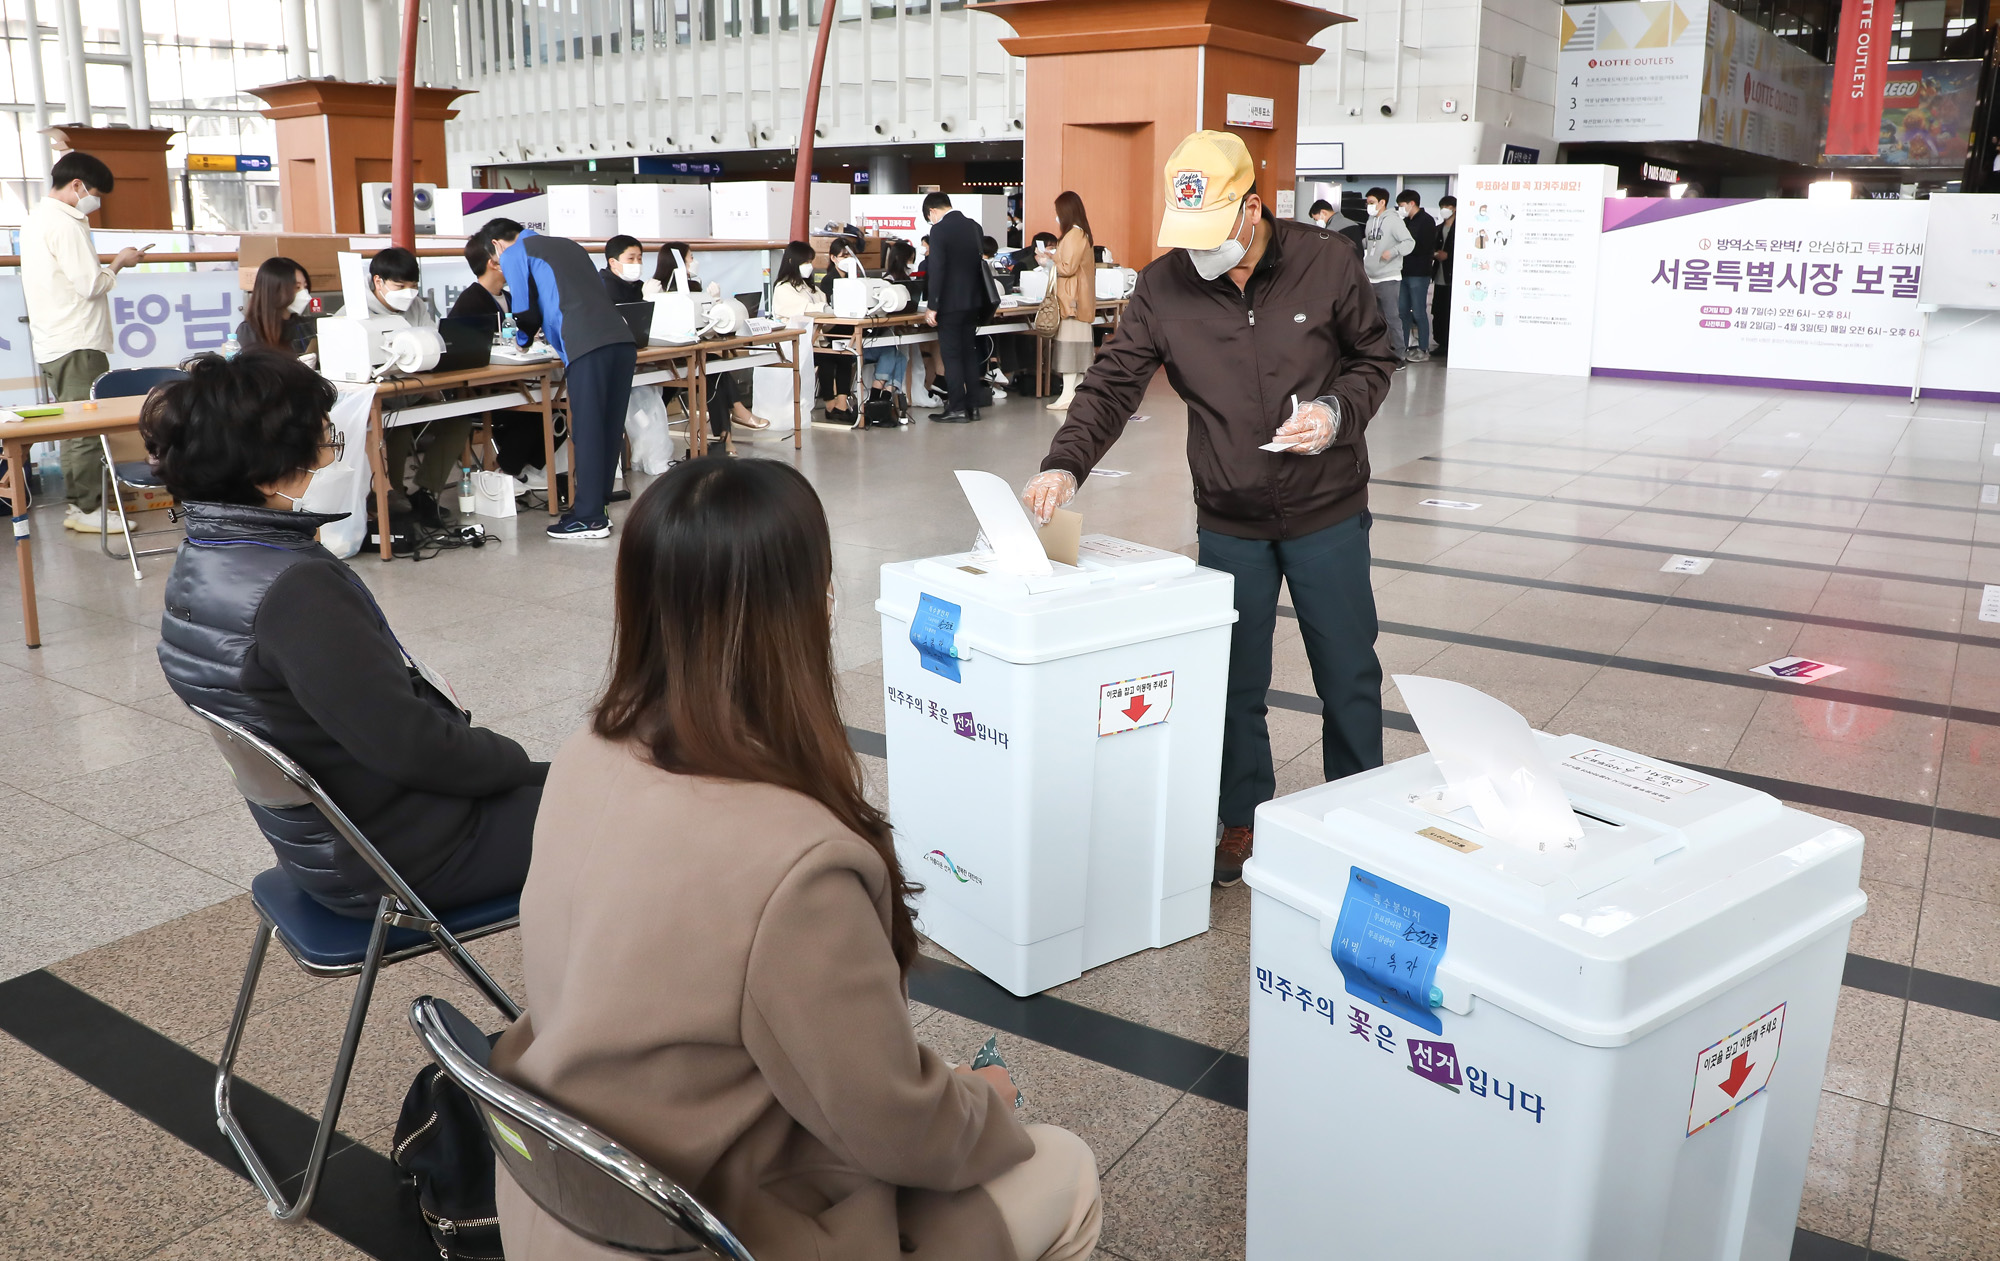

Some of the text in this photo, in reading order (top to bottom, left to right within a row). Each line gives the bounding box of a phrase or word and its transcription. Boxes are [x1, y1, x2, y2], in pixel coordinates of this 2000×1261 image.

[1600, 57, 1674, 67] LOTTE OUTLETS
[1851, 33, 1870, 98] OUTLETS
[1571, 76, 1578, 87] 4
[1883, 82, 1918, 97] LEGO
[1570, 97, 1577, 109] 3
[1751, 80, 1774, 108] LOTTE
[1568, 119, 1576, 130] 2
[1476, 181, 1581, 191] 투표하실 때 꼭 지켜주세요!
[1717, 238, 1923, 256] 방역소독 완벽! 안심하고 투표하세
[1651, 258, 1921, 298] 서울특별시장 보궐
[1735, 307, 1748, 315] 4월
[1751, 307, 1777, 316] 7일(수)
[1779, 308, 1794, 317] 오전
[1836, 311, 1851, 319] 8시
[1734, 321, 1747, 329] 4월
[1750, 321, 1776, 331] 2일(금)
[1784, 323, 1797, 331] 4월
[1800, 323, 1828, 333] 3일(토)
[1830, 325, 1847, 334] 매일
[1849, 326, 1865, 335] 오전
[1107, 679, 1168, 699] 이곳을 잡고 이동해 주세요
[888, 686, 1009, 750] 민주주의 꽃은 선거입니다
[1373, 893, 1420, 922] 특수봉인지
[1255, 965, 1546, 1124] 민주주의 꽃은 선거입니다
[1704, 1017, 1777, 1070] 이곳을 잡고 이동해 주세요
